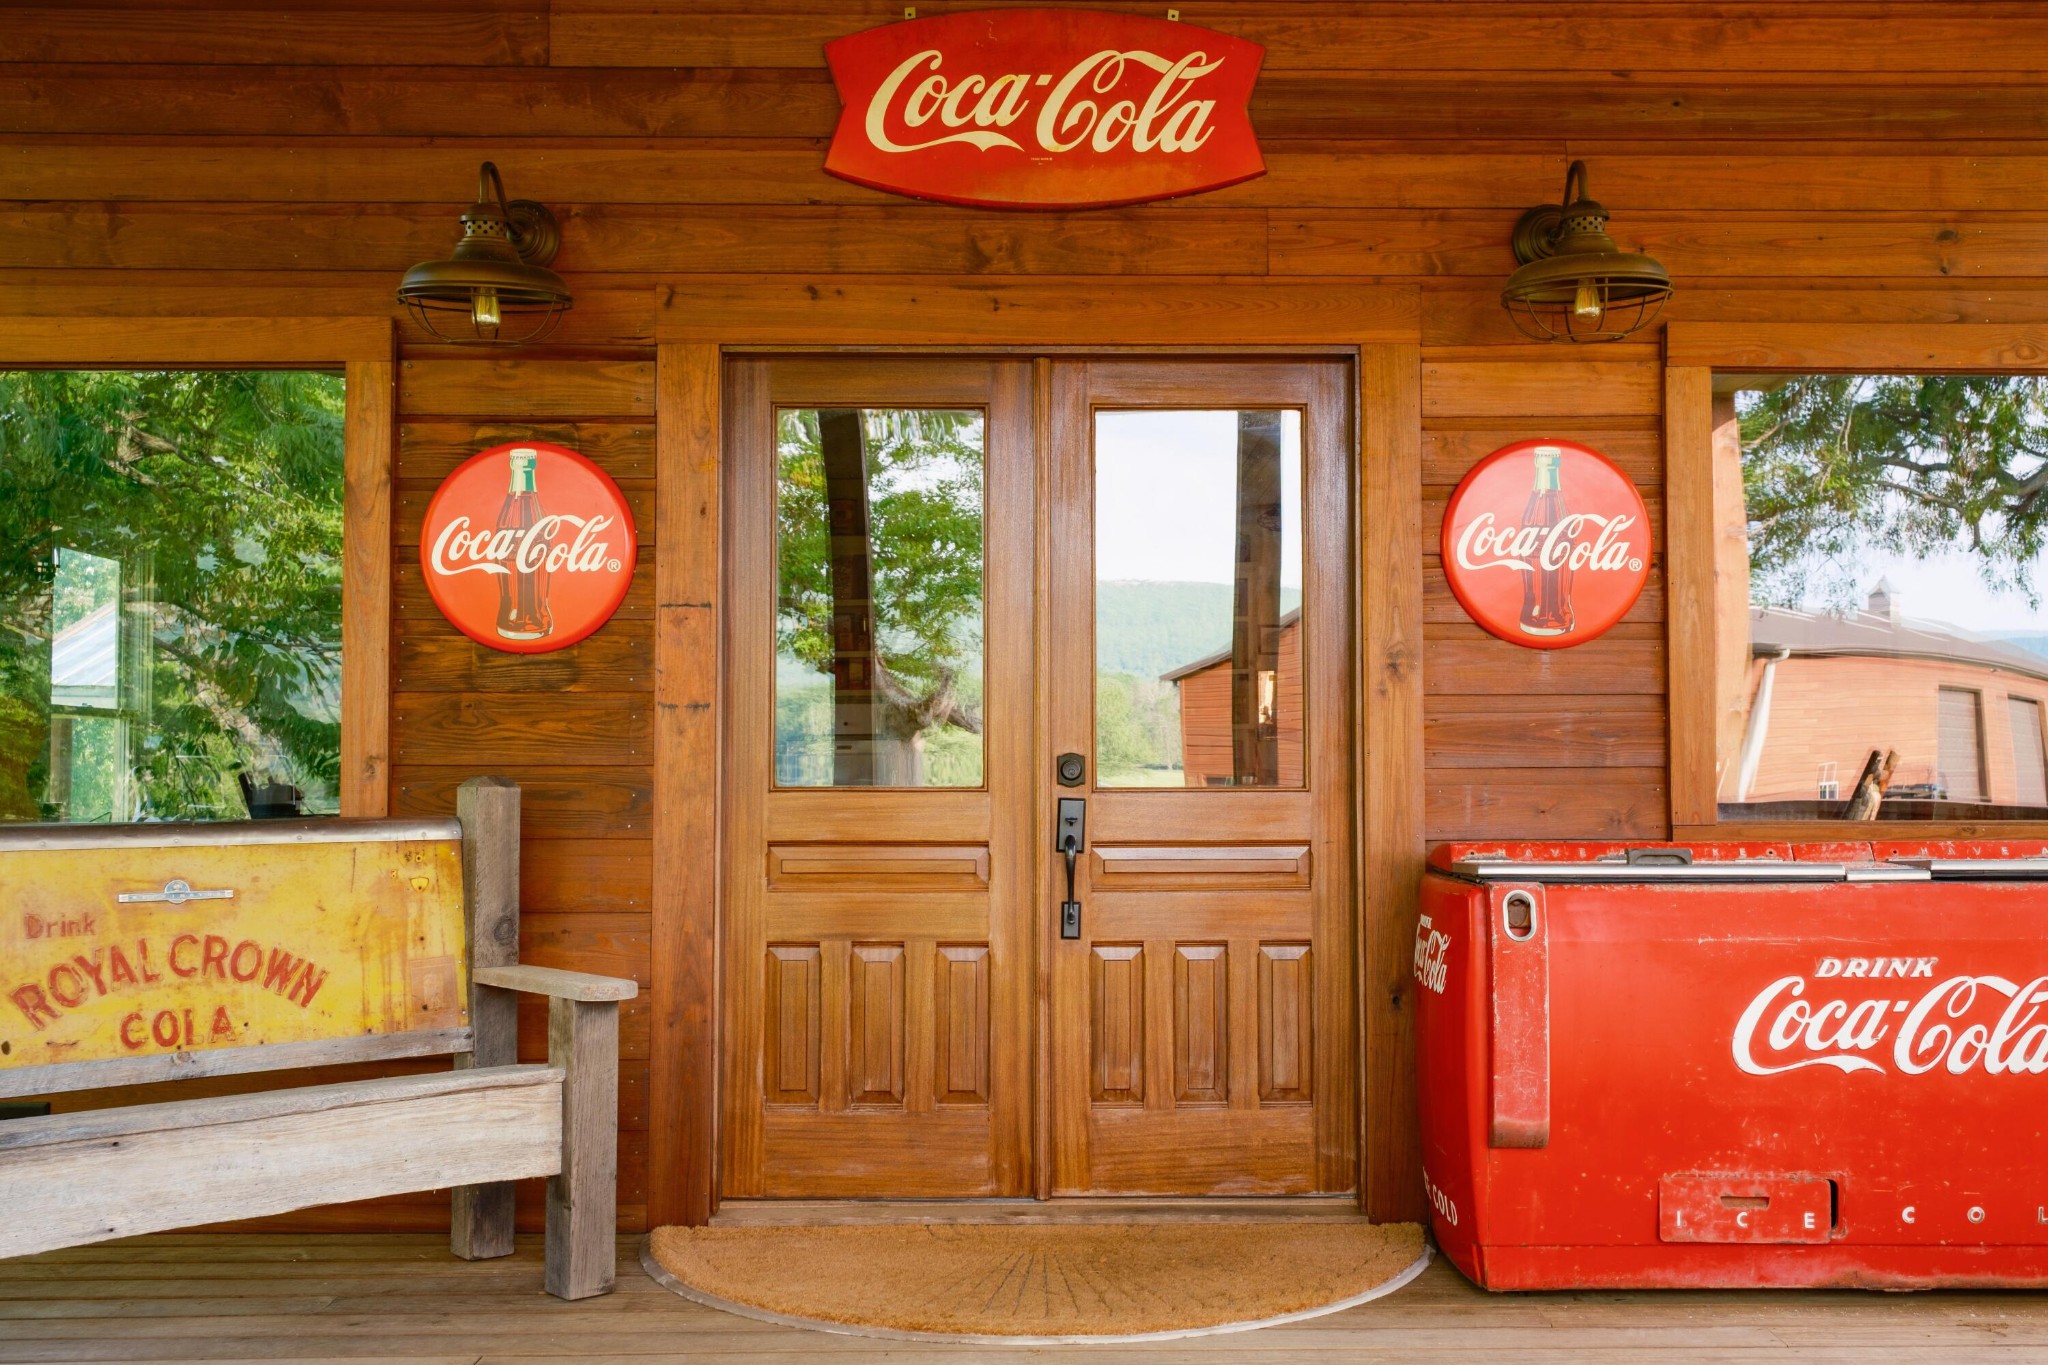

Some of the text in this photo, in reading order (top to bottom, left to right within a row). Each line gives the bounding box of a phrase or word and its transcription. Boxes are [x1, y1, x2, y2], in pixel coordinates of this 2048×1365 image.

[865, 49, 1225, 153] Coca-Cola
[1920, 846, 2010, 856] HAVE
[24, 911, 97, 940] Drink
[9, 934, 331, 1031] ROYAL CROWN
[1814, 956, 1939, 978] DRINK
[120, 1004, 236, 1050] COLA
[1732, 975, 2048, 1076] Coca-Cola
[1432, 1184, 1458, 1227] COLD
[1676, 1210, 1816, 1230] ICE
